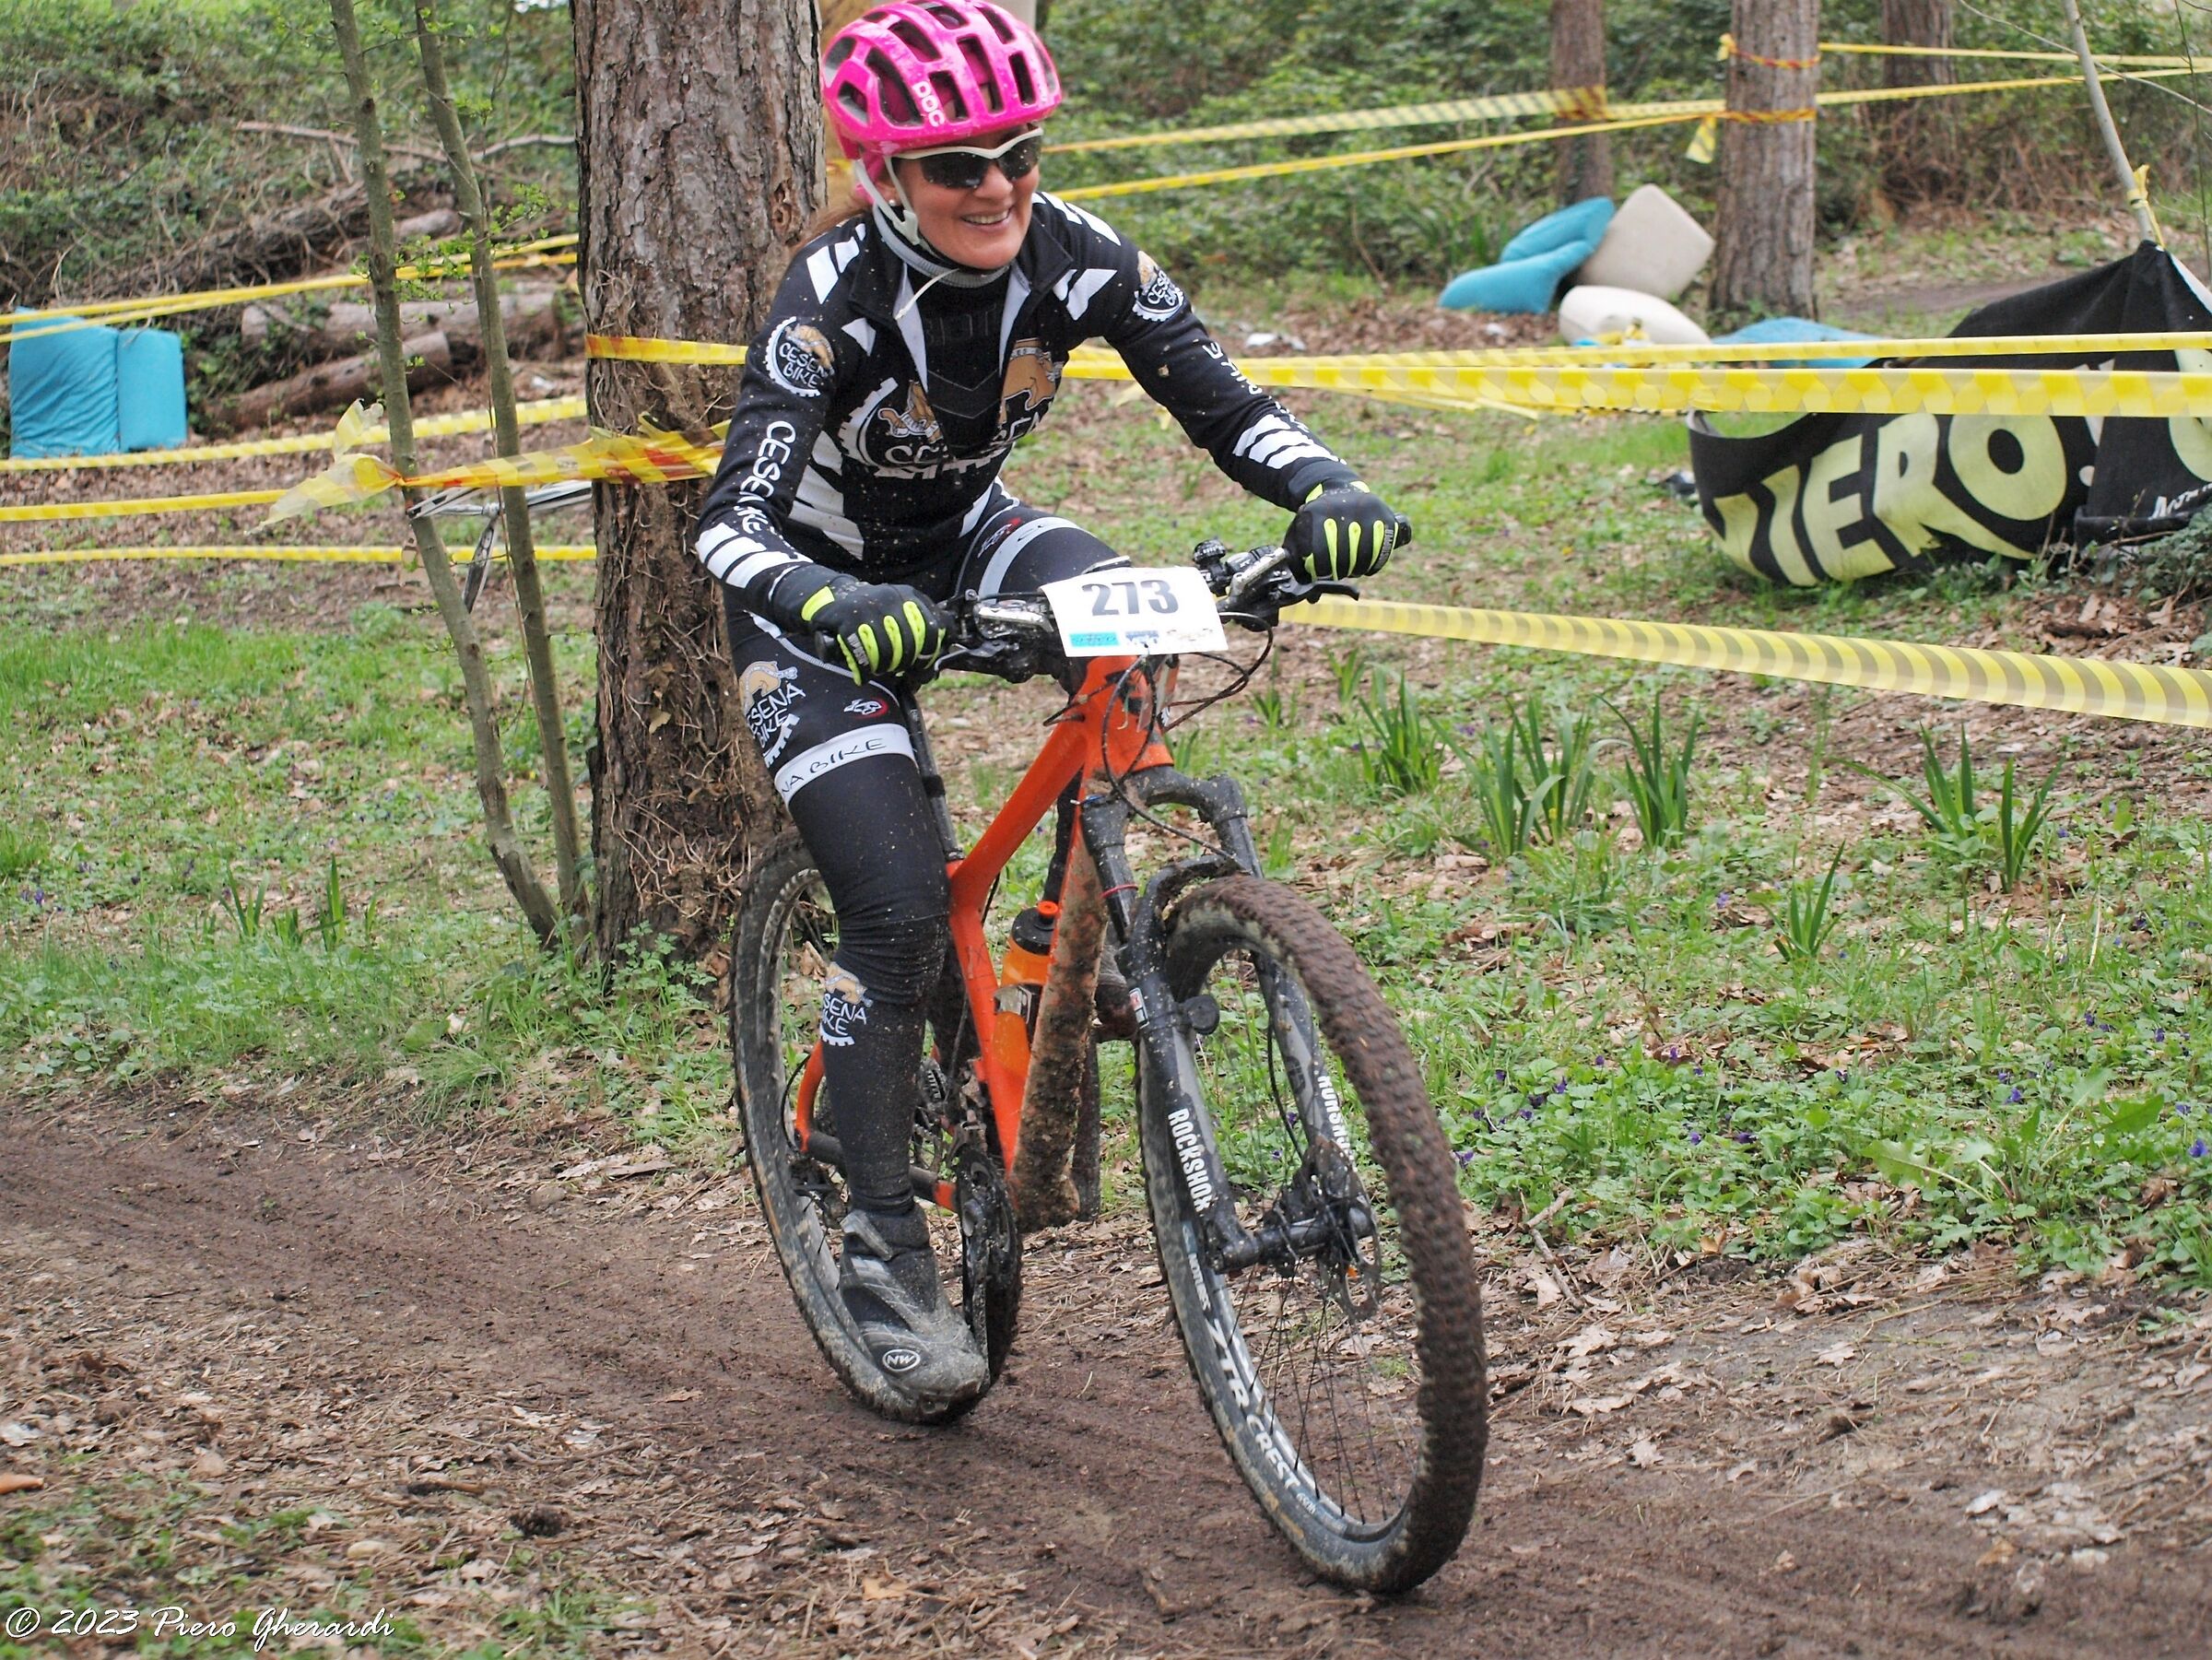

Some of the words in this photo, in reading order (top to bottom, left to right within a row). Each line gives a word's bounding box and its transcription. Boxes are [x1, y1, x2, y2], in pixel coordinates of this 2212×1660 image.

[1081, 580, 1180, 616] 273
[809, 738, 887, 774] BIKE
[1168, 1108, 1213, 1212] ROCKSHOX
[885, 1353, 917, 1368] NW
[1246, 1414, 1301, 1490] CREST
